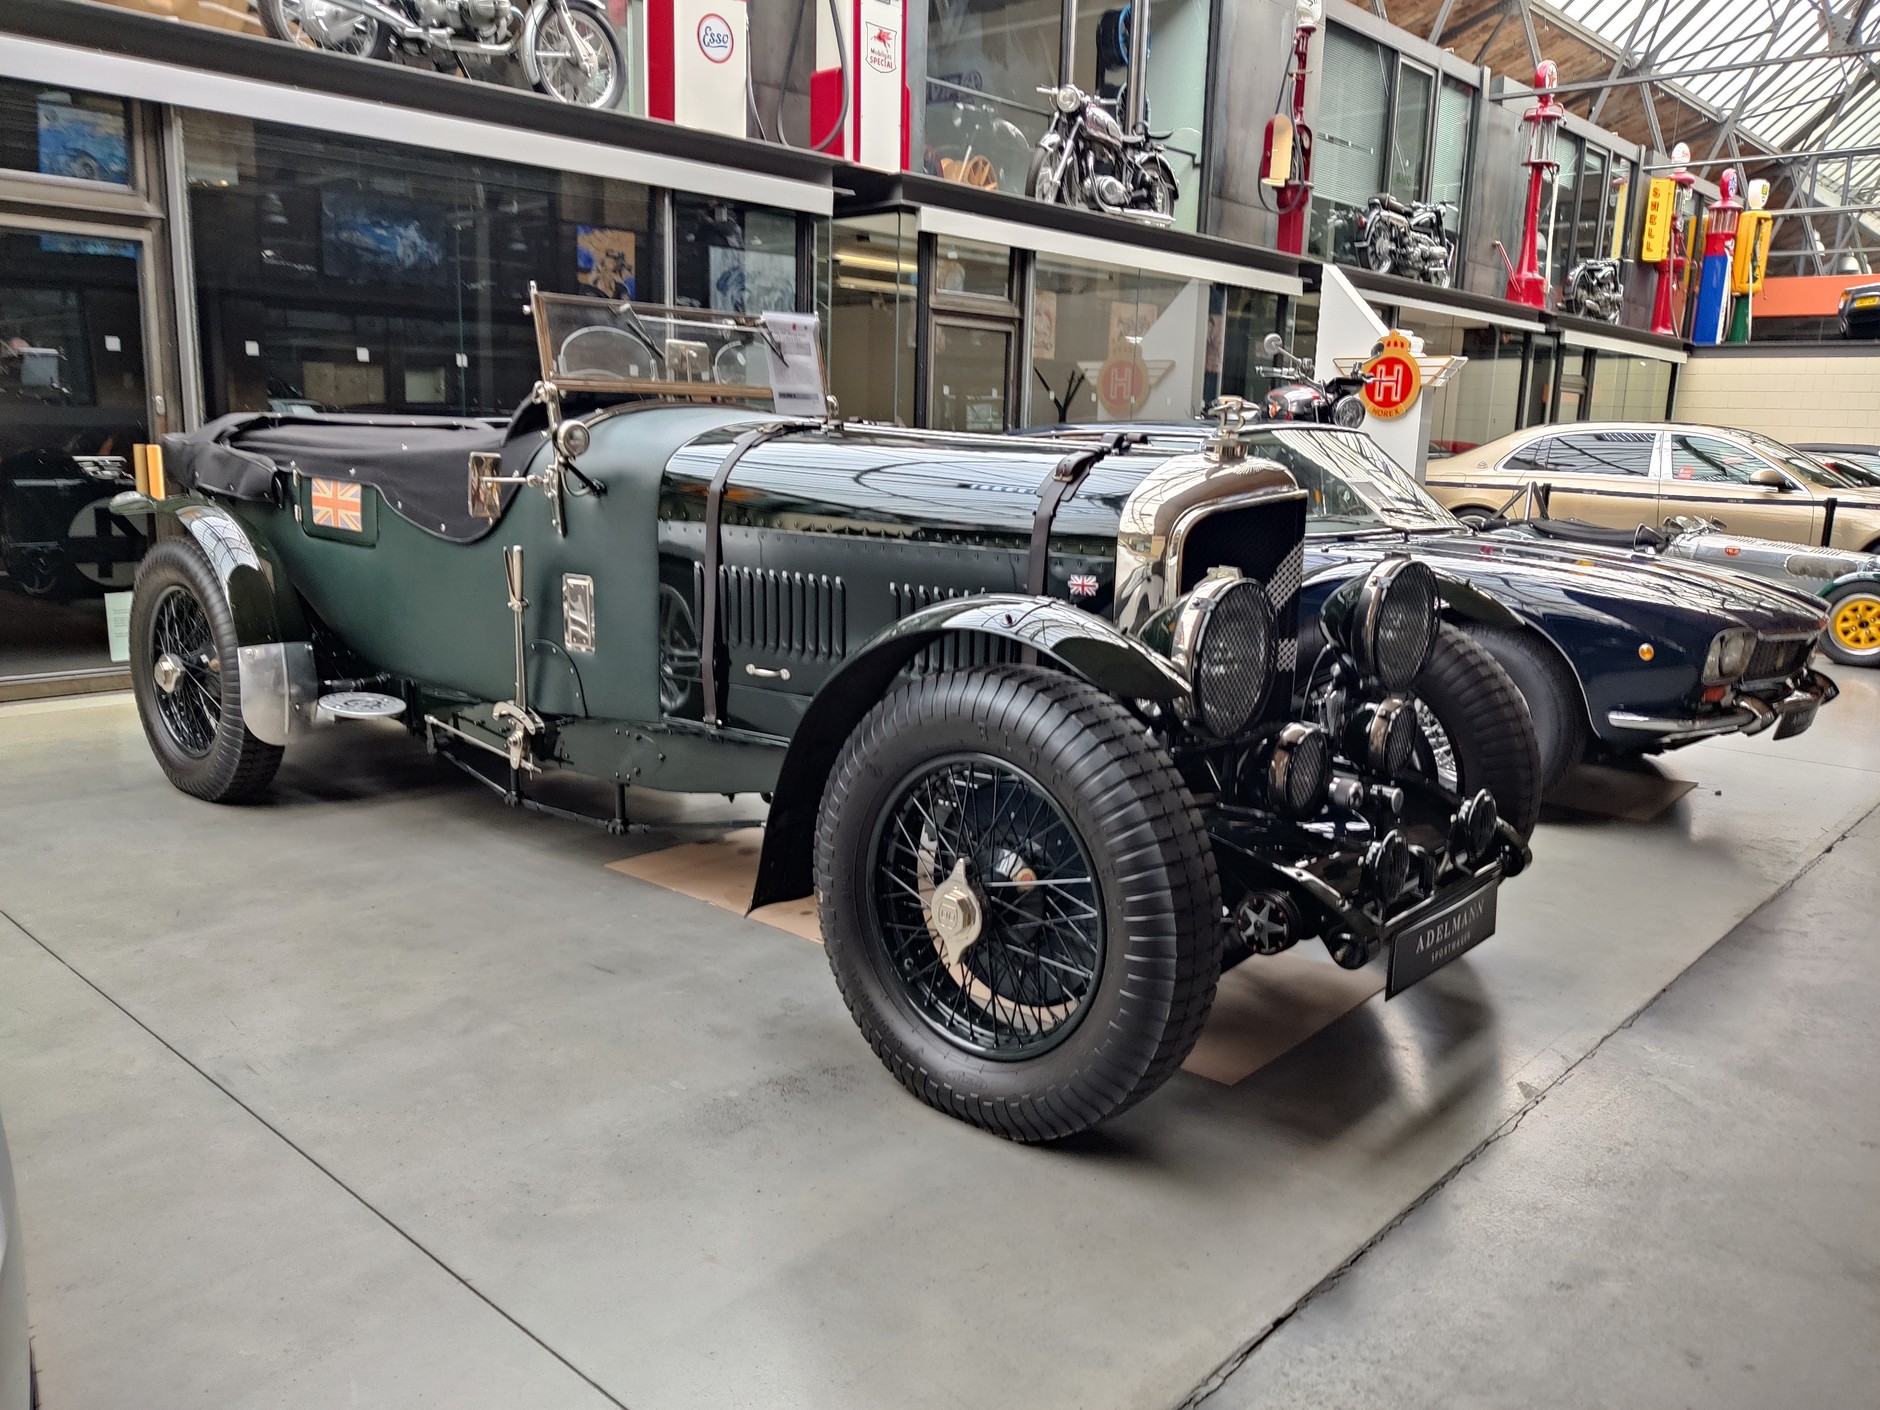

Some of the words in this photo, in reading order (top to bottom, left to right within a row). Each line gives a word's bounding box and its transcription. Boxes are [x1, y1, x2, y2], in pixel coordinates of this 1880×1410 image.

[702, 25, 729, 48] Esso
[869, 55, 893, 69] SPECIAL
[1646, 187, 1661, 253] SHELL
[1374, 364, 1404, 402] H
[1371, 406, 1401, 418] HOREX
[1416, 899, 1484, 955] ADELMANN
